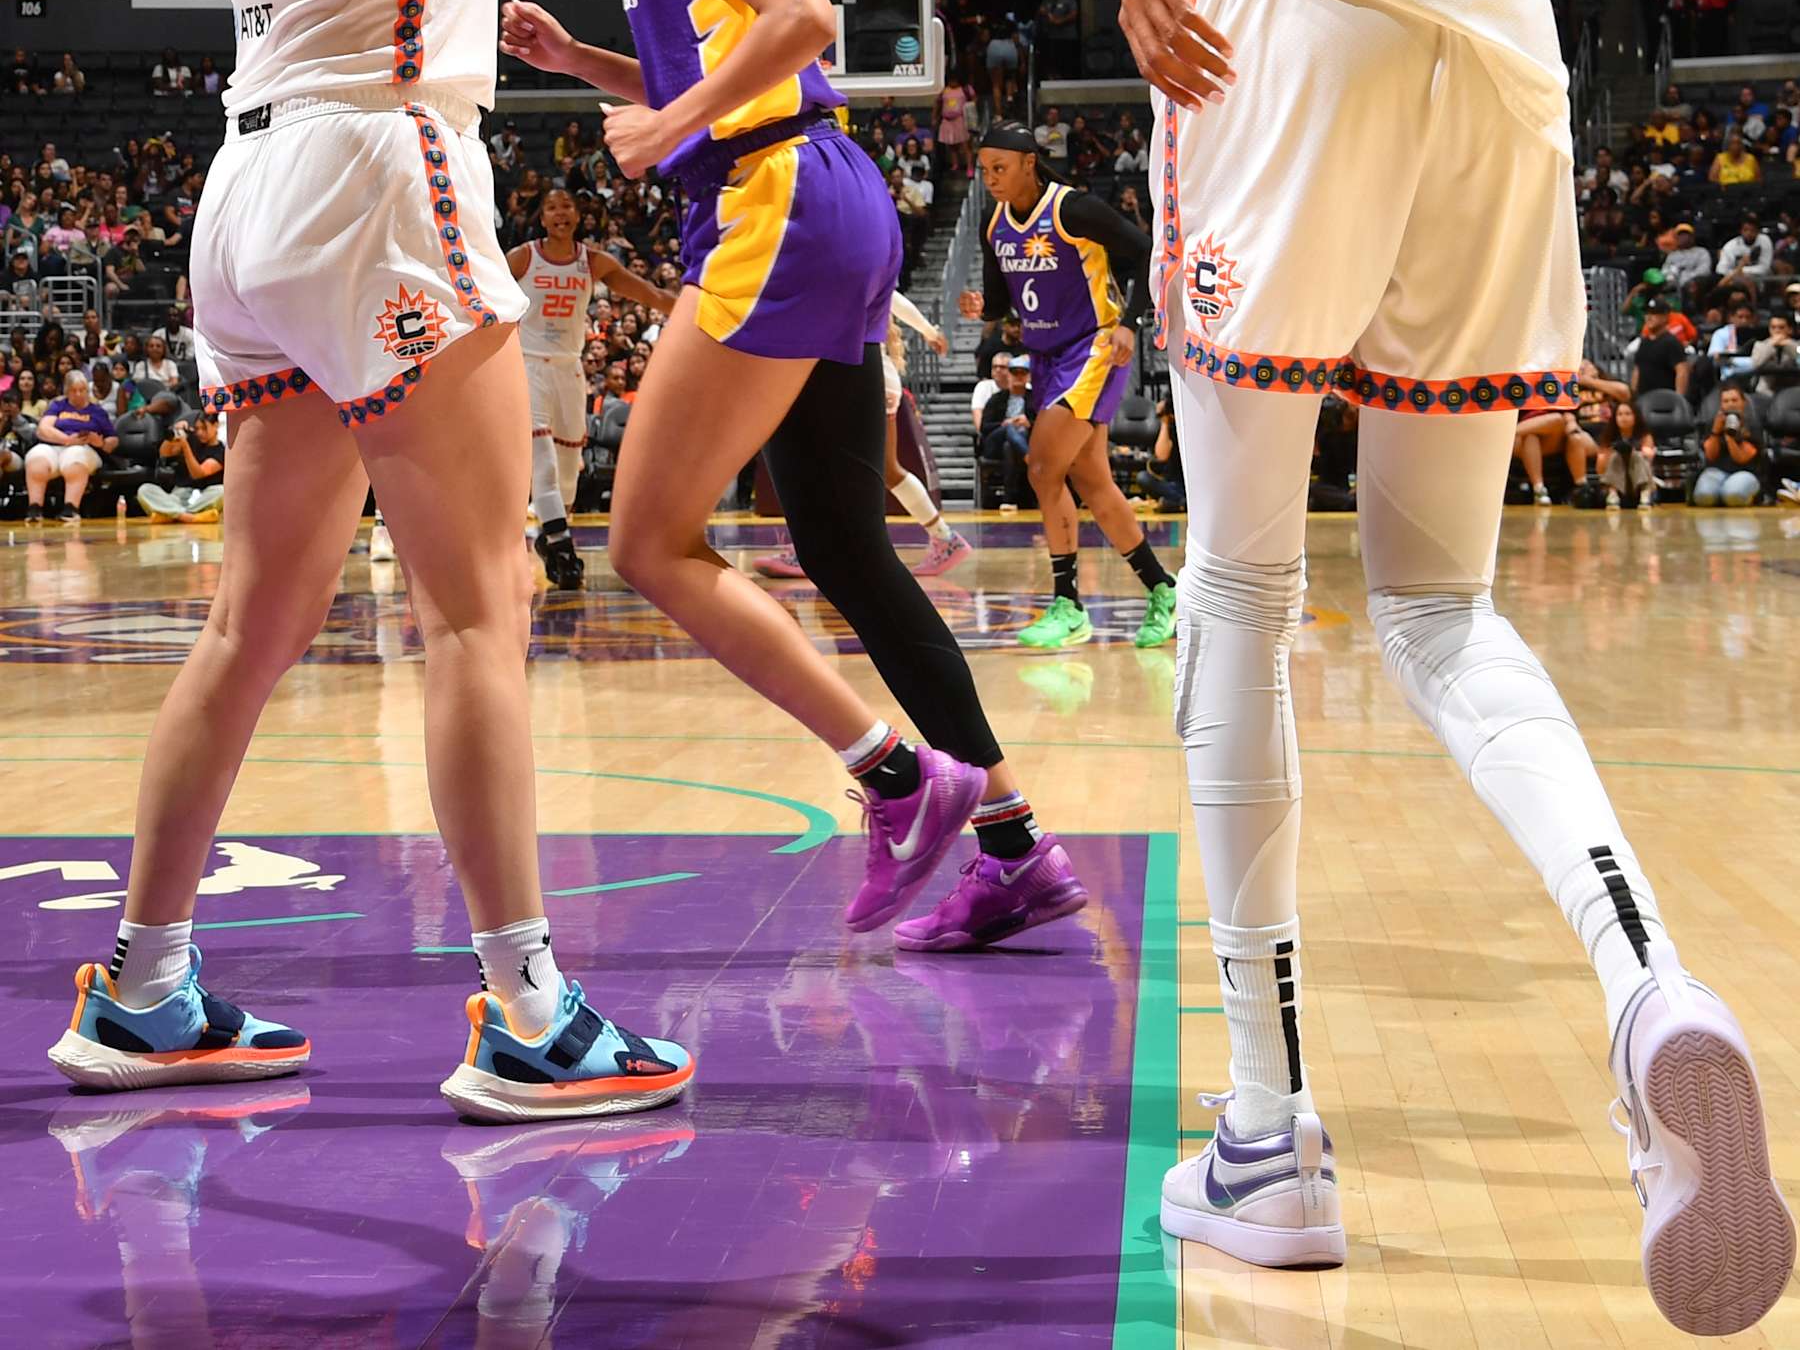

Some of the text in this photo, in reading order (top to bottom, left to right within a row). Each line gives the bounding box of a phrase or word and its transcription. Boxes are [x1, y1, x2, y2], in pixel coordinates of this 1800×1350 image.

[21, 1, 42, 16] 106
[240, 3, 273, 42] AT&T
[892, 63, 924, 77] AT&T
[533, 275, 586, 290] SUN
[542, 294, 577, 318] 25
[1021, 278, 1039, 312] 6
[395, 311, 426, 340] C
